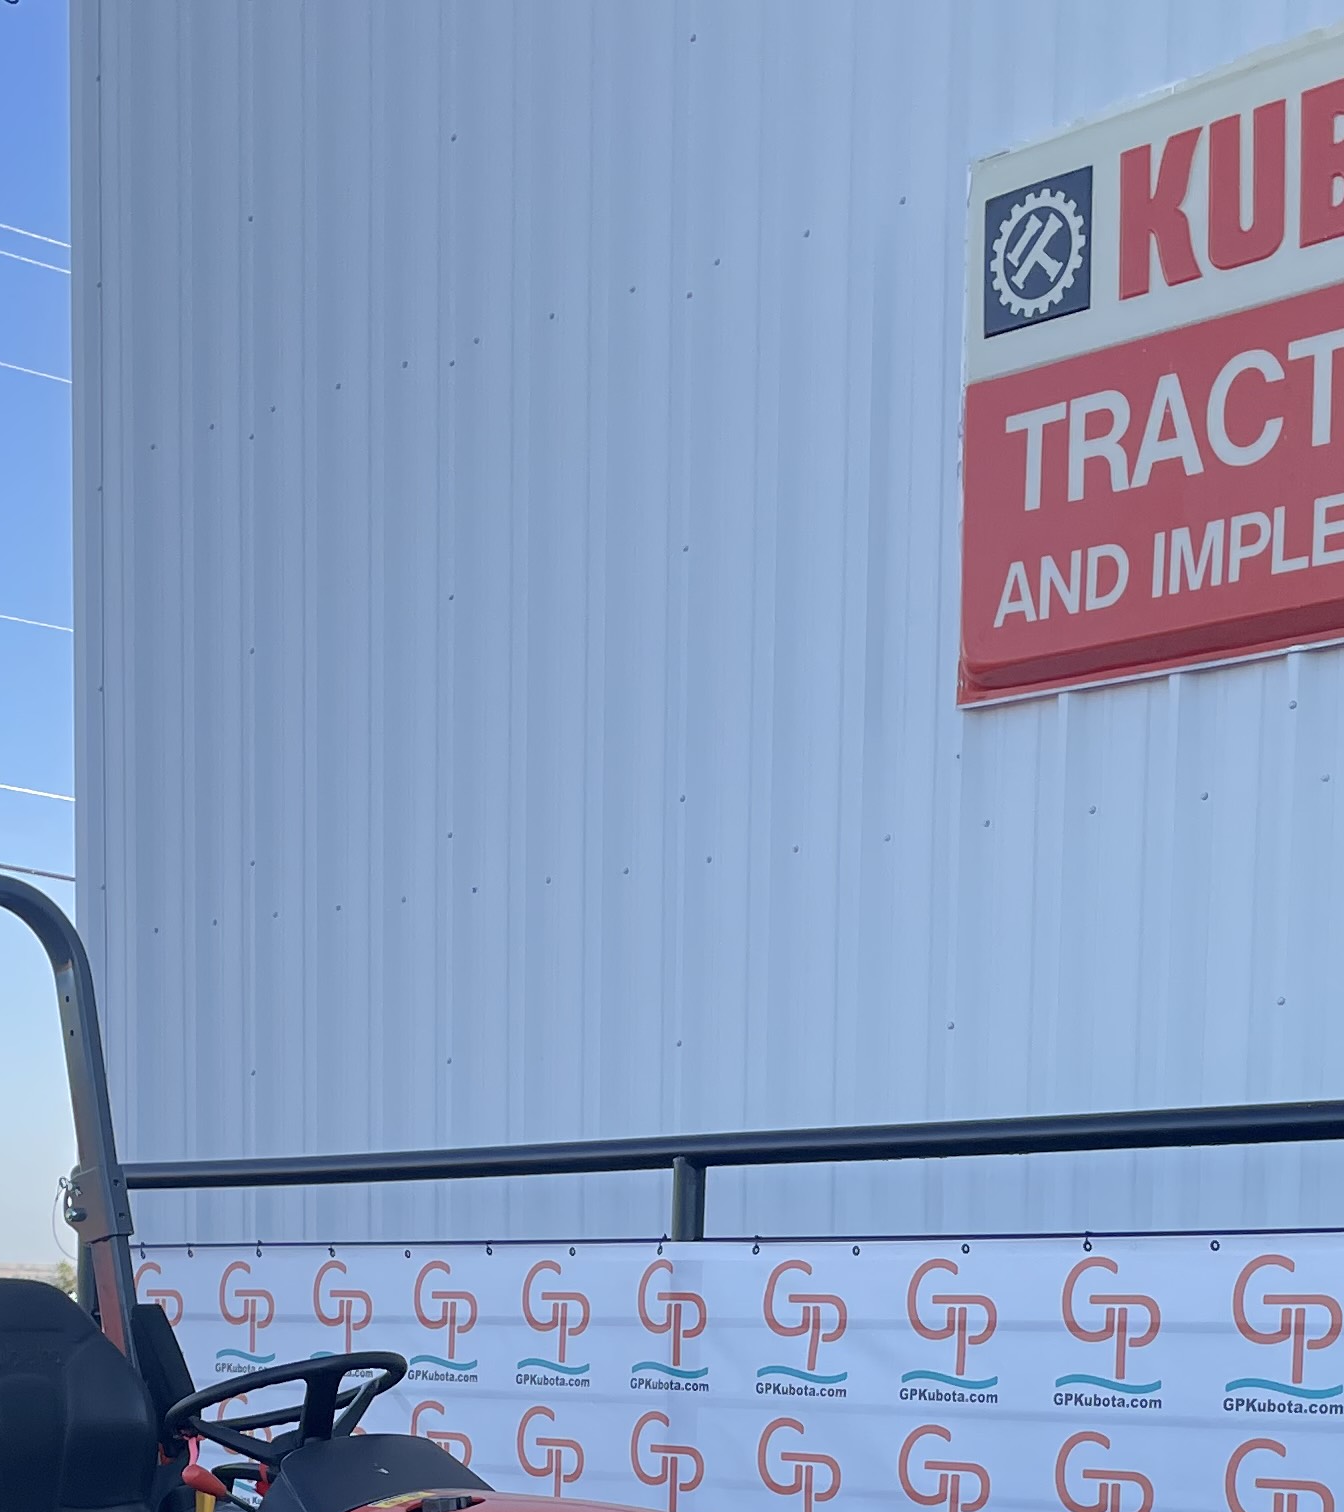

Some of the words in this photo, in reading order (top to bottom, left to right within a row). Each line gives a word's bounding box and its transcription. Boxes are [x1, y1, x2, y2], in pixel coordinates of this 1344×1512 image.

[994, 544, 1129, 629] AND
[219, 1260, 275, 1353] GP
[313, 1260, 373, 1354] GP
[414, 1260, 478, 1360] GP
[522, 1260, 591, 1363] GP
[637, 1260, 707, 1367] GP
[763, 1260, 847, 1371] GP
[907, 1258, 997, 1376] GP
[1062, 1256, 1161, 1379] GP
[1233, 1254, 1343, 1384] GP
[215, 1362, 270, 1374] GPKubota.c
[408, 1370, 479, 1383] GPKubota.com
[516, 1373, 591, 1388] GPKubota.com
[630, 1378, 710, 1392] GPKubota.com
[756, 1382, 847, 1398] GPKubota.com
[899, 1387, 999, 1404] GPKubota.com
[1053, 1392, 1163, 1410] GPKubota.com
[1223, 1397, 1344, 1415] GPKubota.com
[516, 1406, 585, 1498] GP
[630, 1411, 705, 1512] GP
